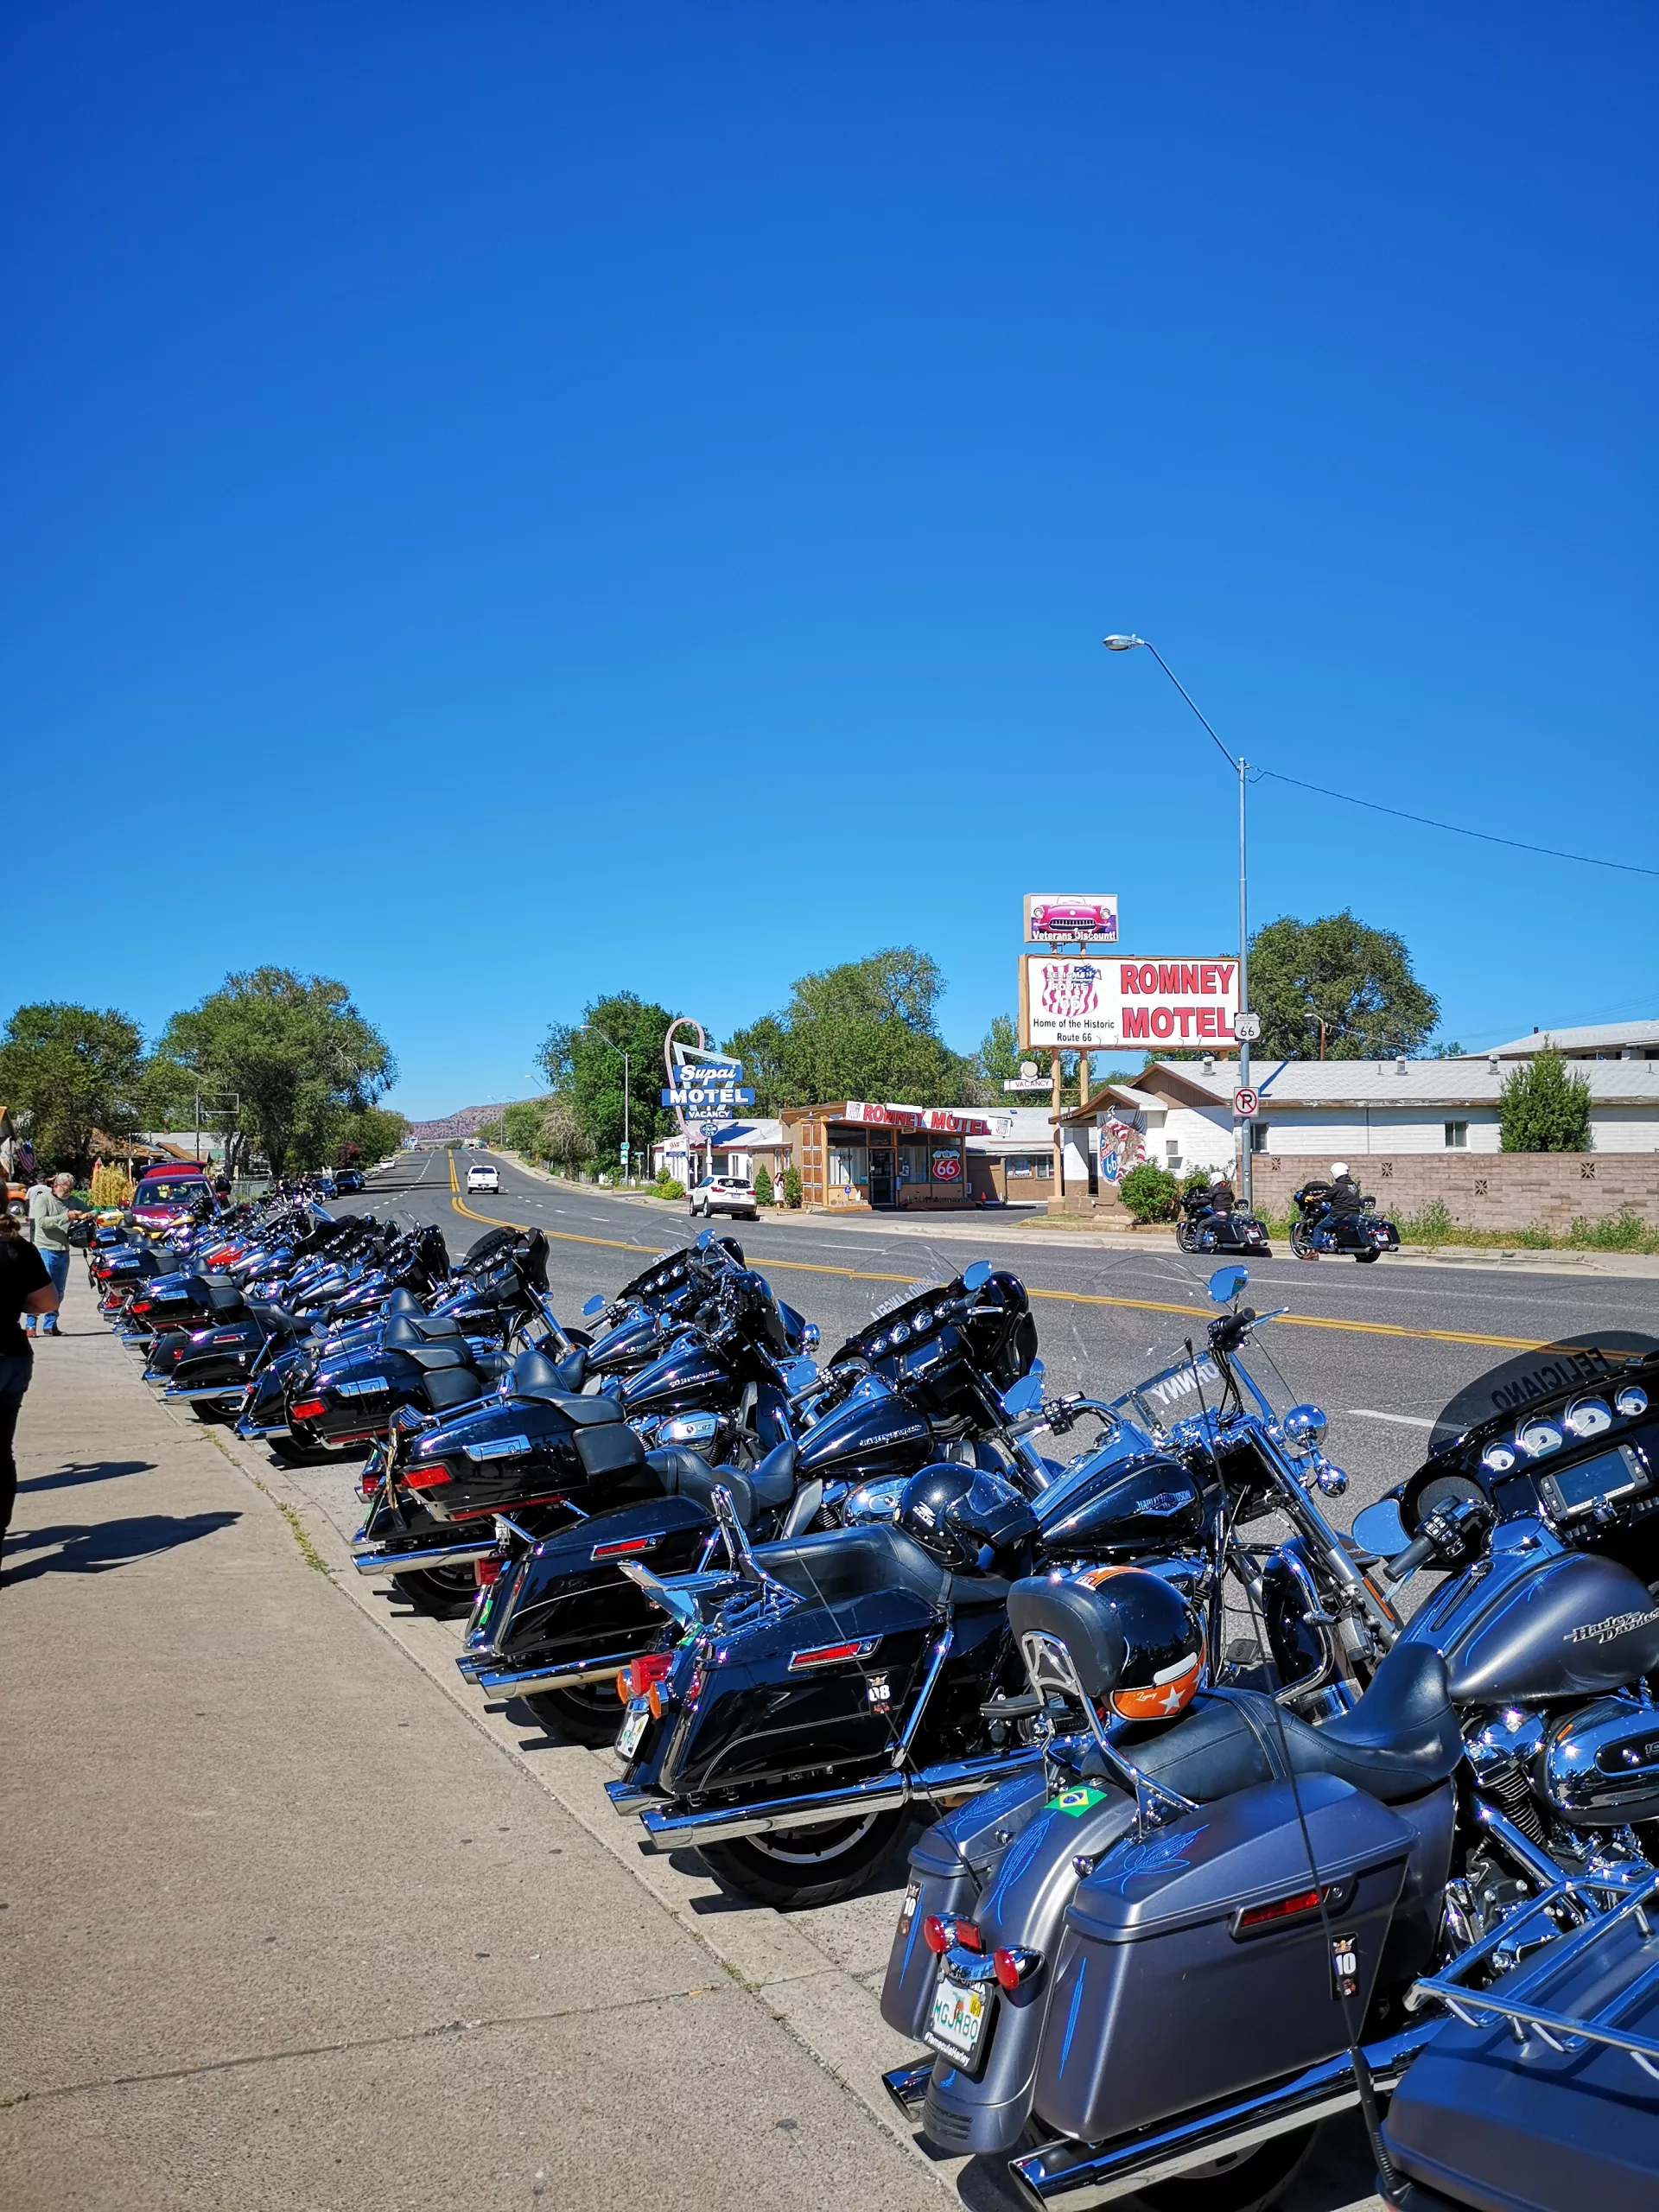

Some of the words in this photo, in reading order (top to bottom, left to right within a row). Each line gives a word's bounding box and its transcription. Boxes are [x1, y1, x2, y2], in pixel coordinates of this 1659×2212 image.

[1033, 931, 1072, 940] Veterans
[1121, 963, 1235, 994] ROMNEY
[1059, 995, 1081, 1010] 66
[1033, 1019, 1056, 1027] Home
[1058, 1019, 1066, 1027] of
[1084, 1020, 1115, 1028] Historic
[1122, 1007, 1235, 1038] MOTEL
[1057, 1033, 1080, 1041] Route
[1082, 1033, 1092, 1042] 66
[1241, 1027, 1255, 1036] 66
[680, 1065, 736, 1085] Supai
[1014, 1079, 1050, 1089] VACANCY
[670, 1089, 749, 1103] MOTEL
[863, 1104, 926, 1127] ROMNEY
[931, 1111, 992, 1135] MOTEL
[938, 1160, 956, 1175] 66
[1107, 1154, 1116, 1174] 66
[904, 1897, 916, 1916] 10
[1336, 1952, 1357, 1975] 10
